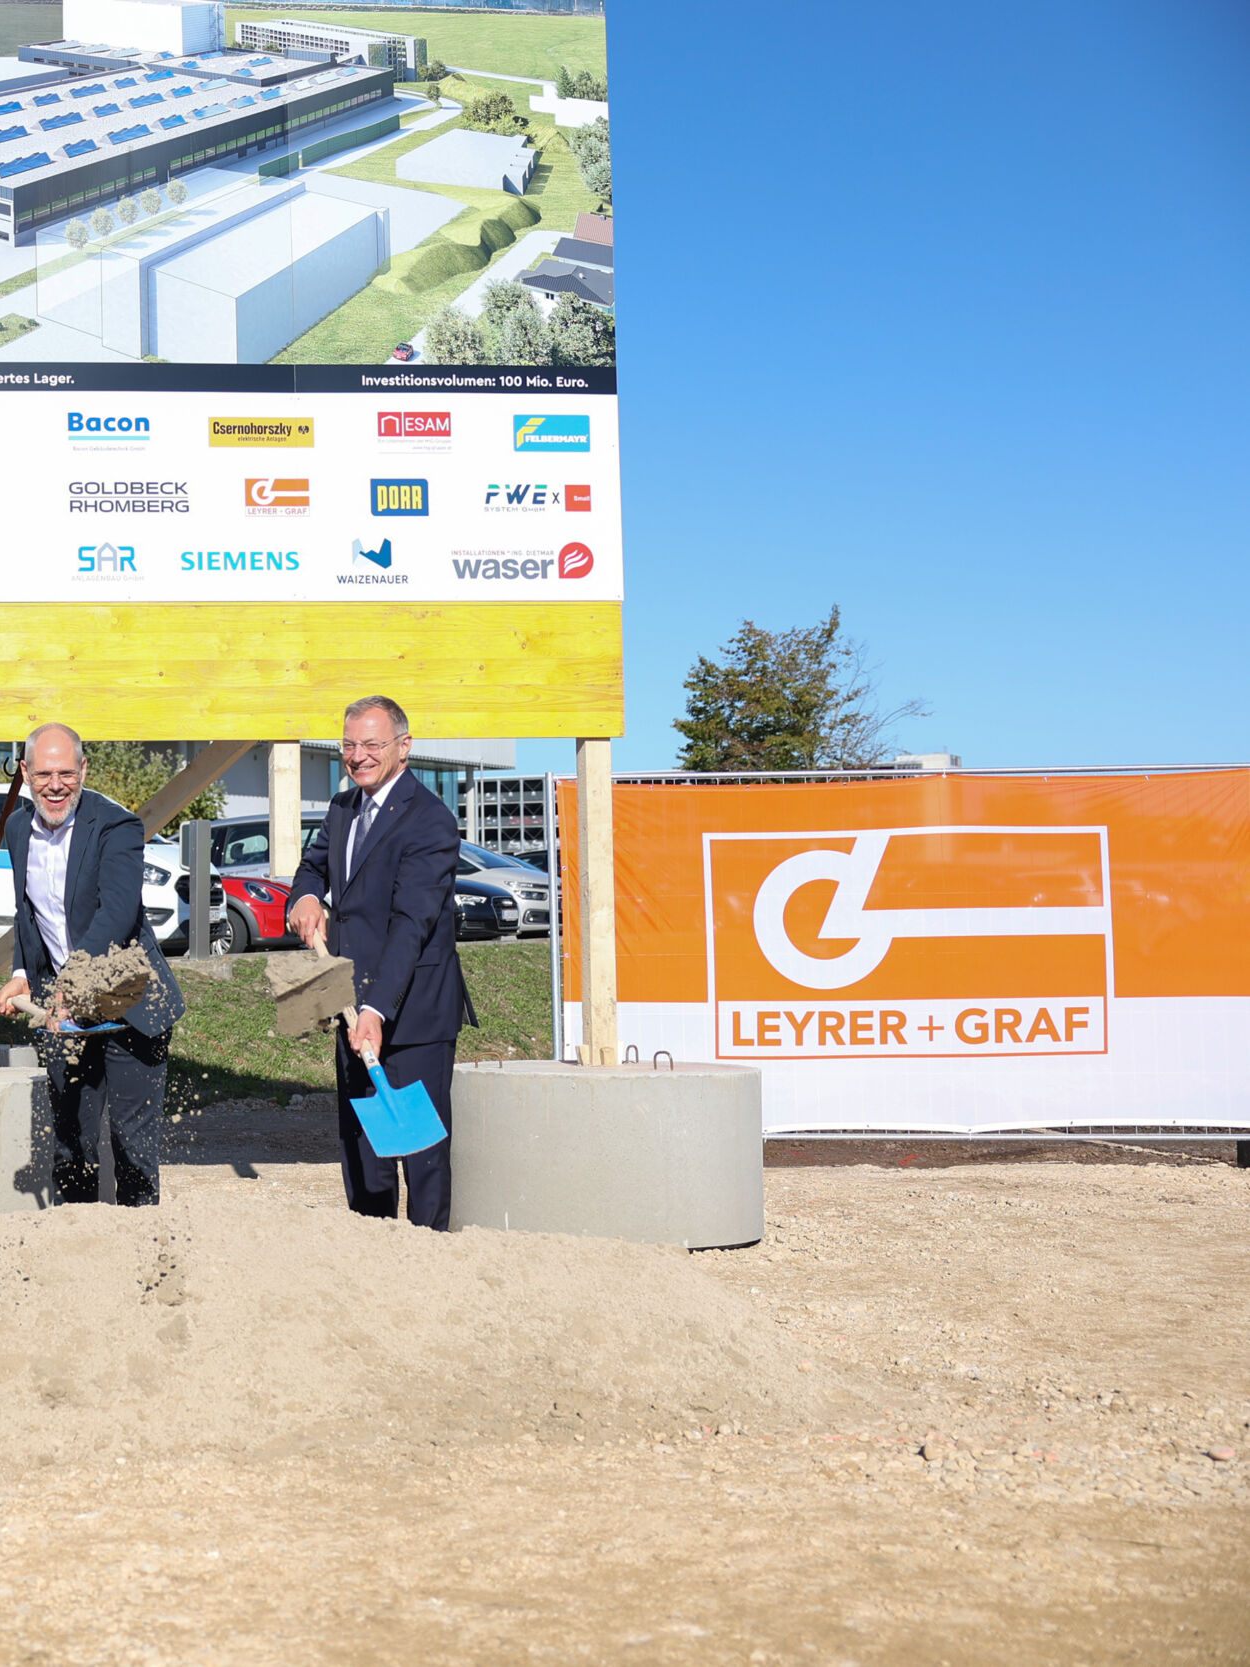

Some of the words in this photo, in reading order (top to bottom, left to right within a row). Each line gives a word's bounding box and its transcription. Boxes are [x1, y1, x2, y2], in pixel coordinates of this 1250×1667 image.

[34, 373, 74, 386] Lager.
[362, 374, 495, 386] Investitionsvolumen:
[499, 376, 522, 386] 100
[526, 375, 552, 387] Mio.
[557, 377, 588, 387] Euro.
[68, 413, 149, 431] Bacon
[213, 422, 291, 436] Csernohorszky
[405, 417, 450, 431] ESAM
[525, 434, 587, 443] FELBERMAYR
[69, 482, 188, 494] GOLDBECK
[486, 484, 547, 504] PWE
[70, 500, 189, 512] RHOMBERG
[78, 543, 137, 572] SAR
[182, 552, 299, 570] SIEMENS
[452, 559, 554, 579] waser
[337, 575, 408, 584] WAIZENAUER
[731, 1011, 907, 1046] LEYRER
[918, 1016, 944, 1041] +
[955, 1007, 1089, 1044] GRAF
